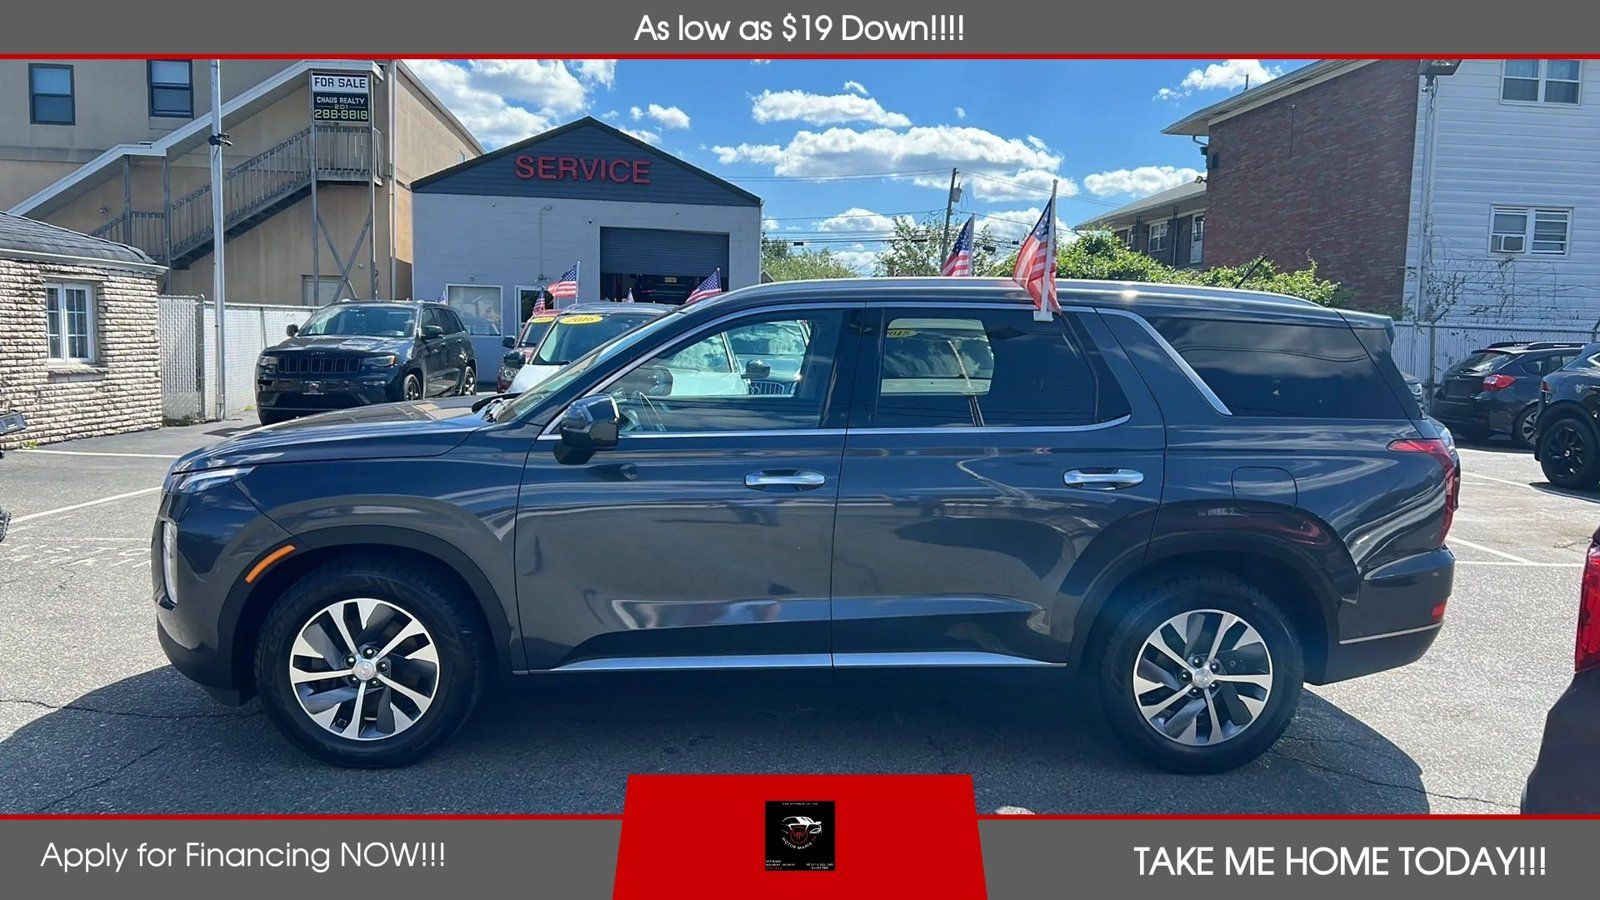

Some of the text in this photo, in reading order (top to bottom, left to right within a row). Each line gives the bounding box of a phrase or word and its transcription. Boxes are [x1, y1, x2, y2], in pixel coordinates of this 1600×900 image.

[314, 77, 366, 88] FOR SALE
[515, 154, 651, 184] SERVICE
